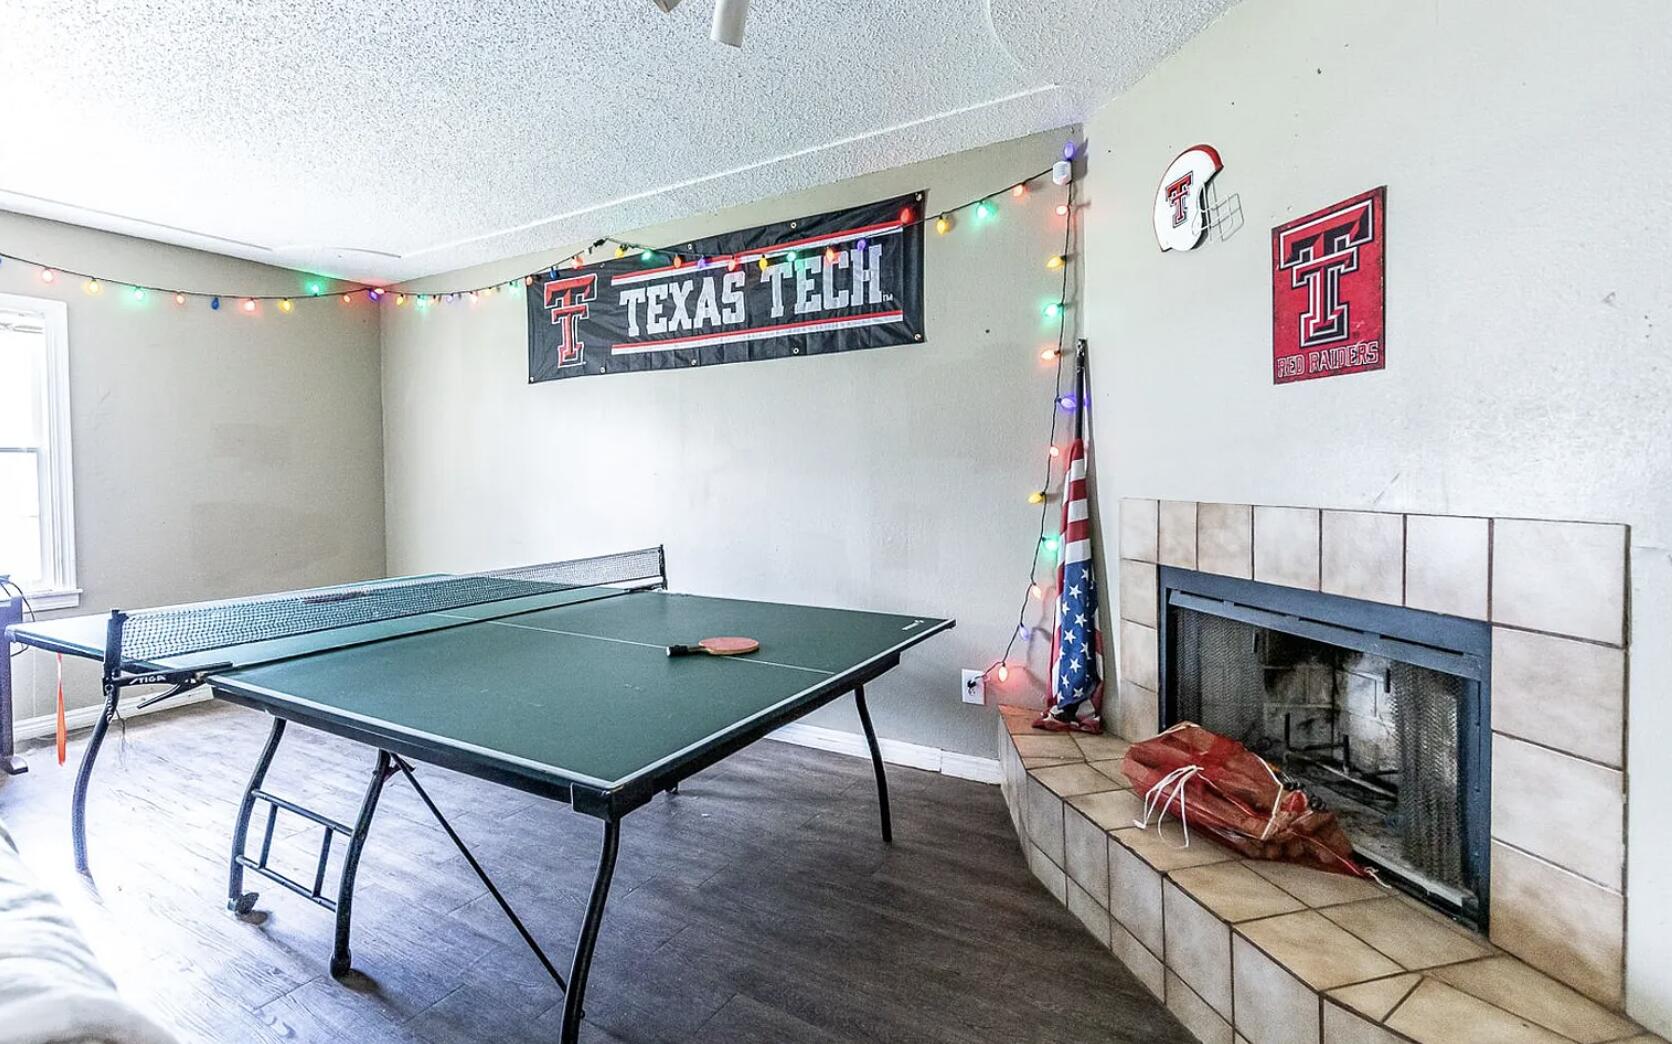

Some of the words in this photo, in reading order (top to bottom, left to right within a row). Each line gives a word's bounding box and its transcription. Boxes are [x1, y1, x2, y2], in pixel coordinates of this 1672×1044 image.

[618, 271, 746, 338] TEXAS
[760, 243, 884, 319] TECH
[1277, 353, 1305, 378] RED
[1308, 340, 1379, 373] RAIDERS
